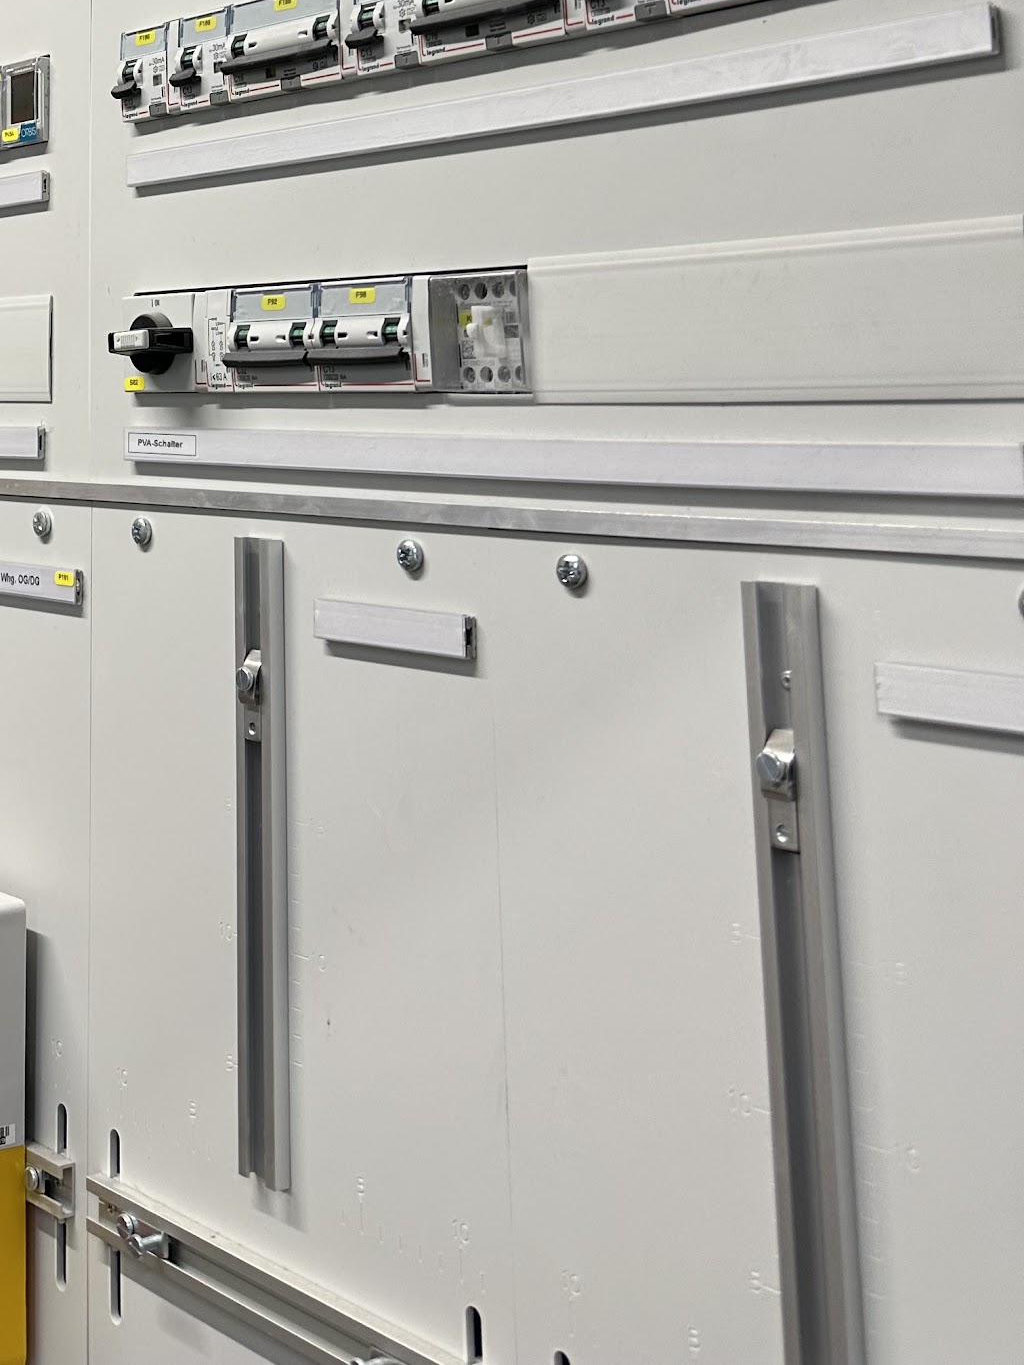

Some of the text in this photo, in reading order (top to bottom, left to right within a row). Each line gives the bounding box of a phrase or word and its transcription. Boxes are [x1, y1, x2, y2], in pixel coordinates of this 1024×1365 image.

[591, 14, 615, 26] legrand
[426, 46, 446, 56] legrand
[0, 572, 40, 586] Whg. OG/DG
